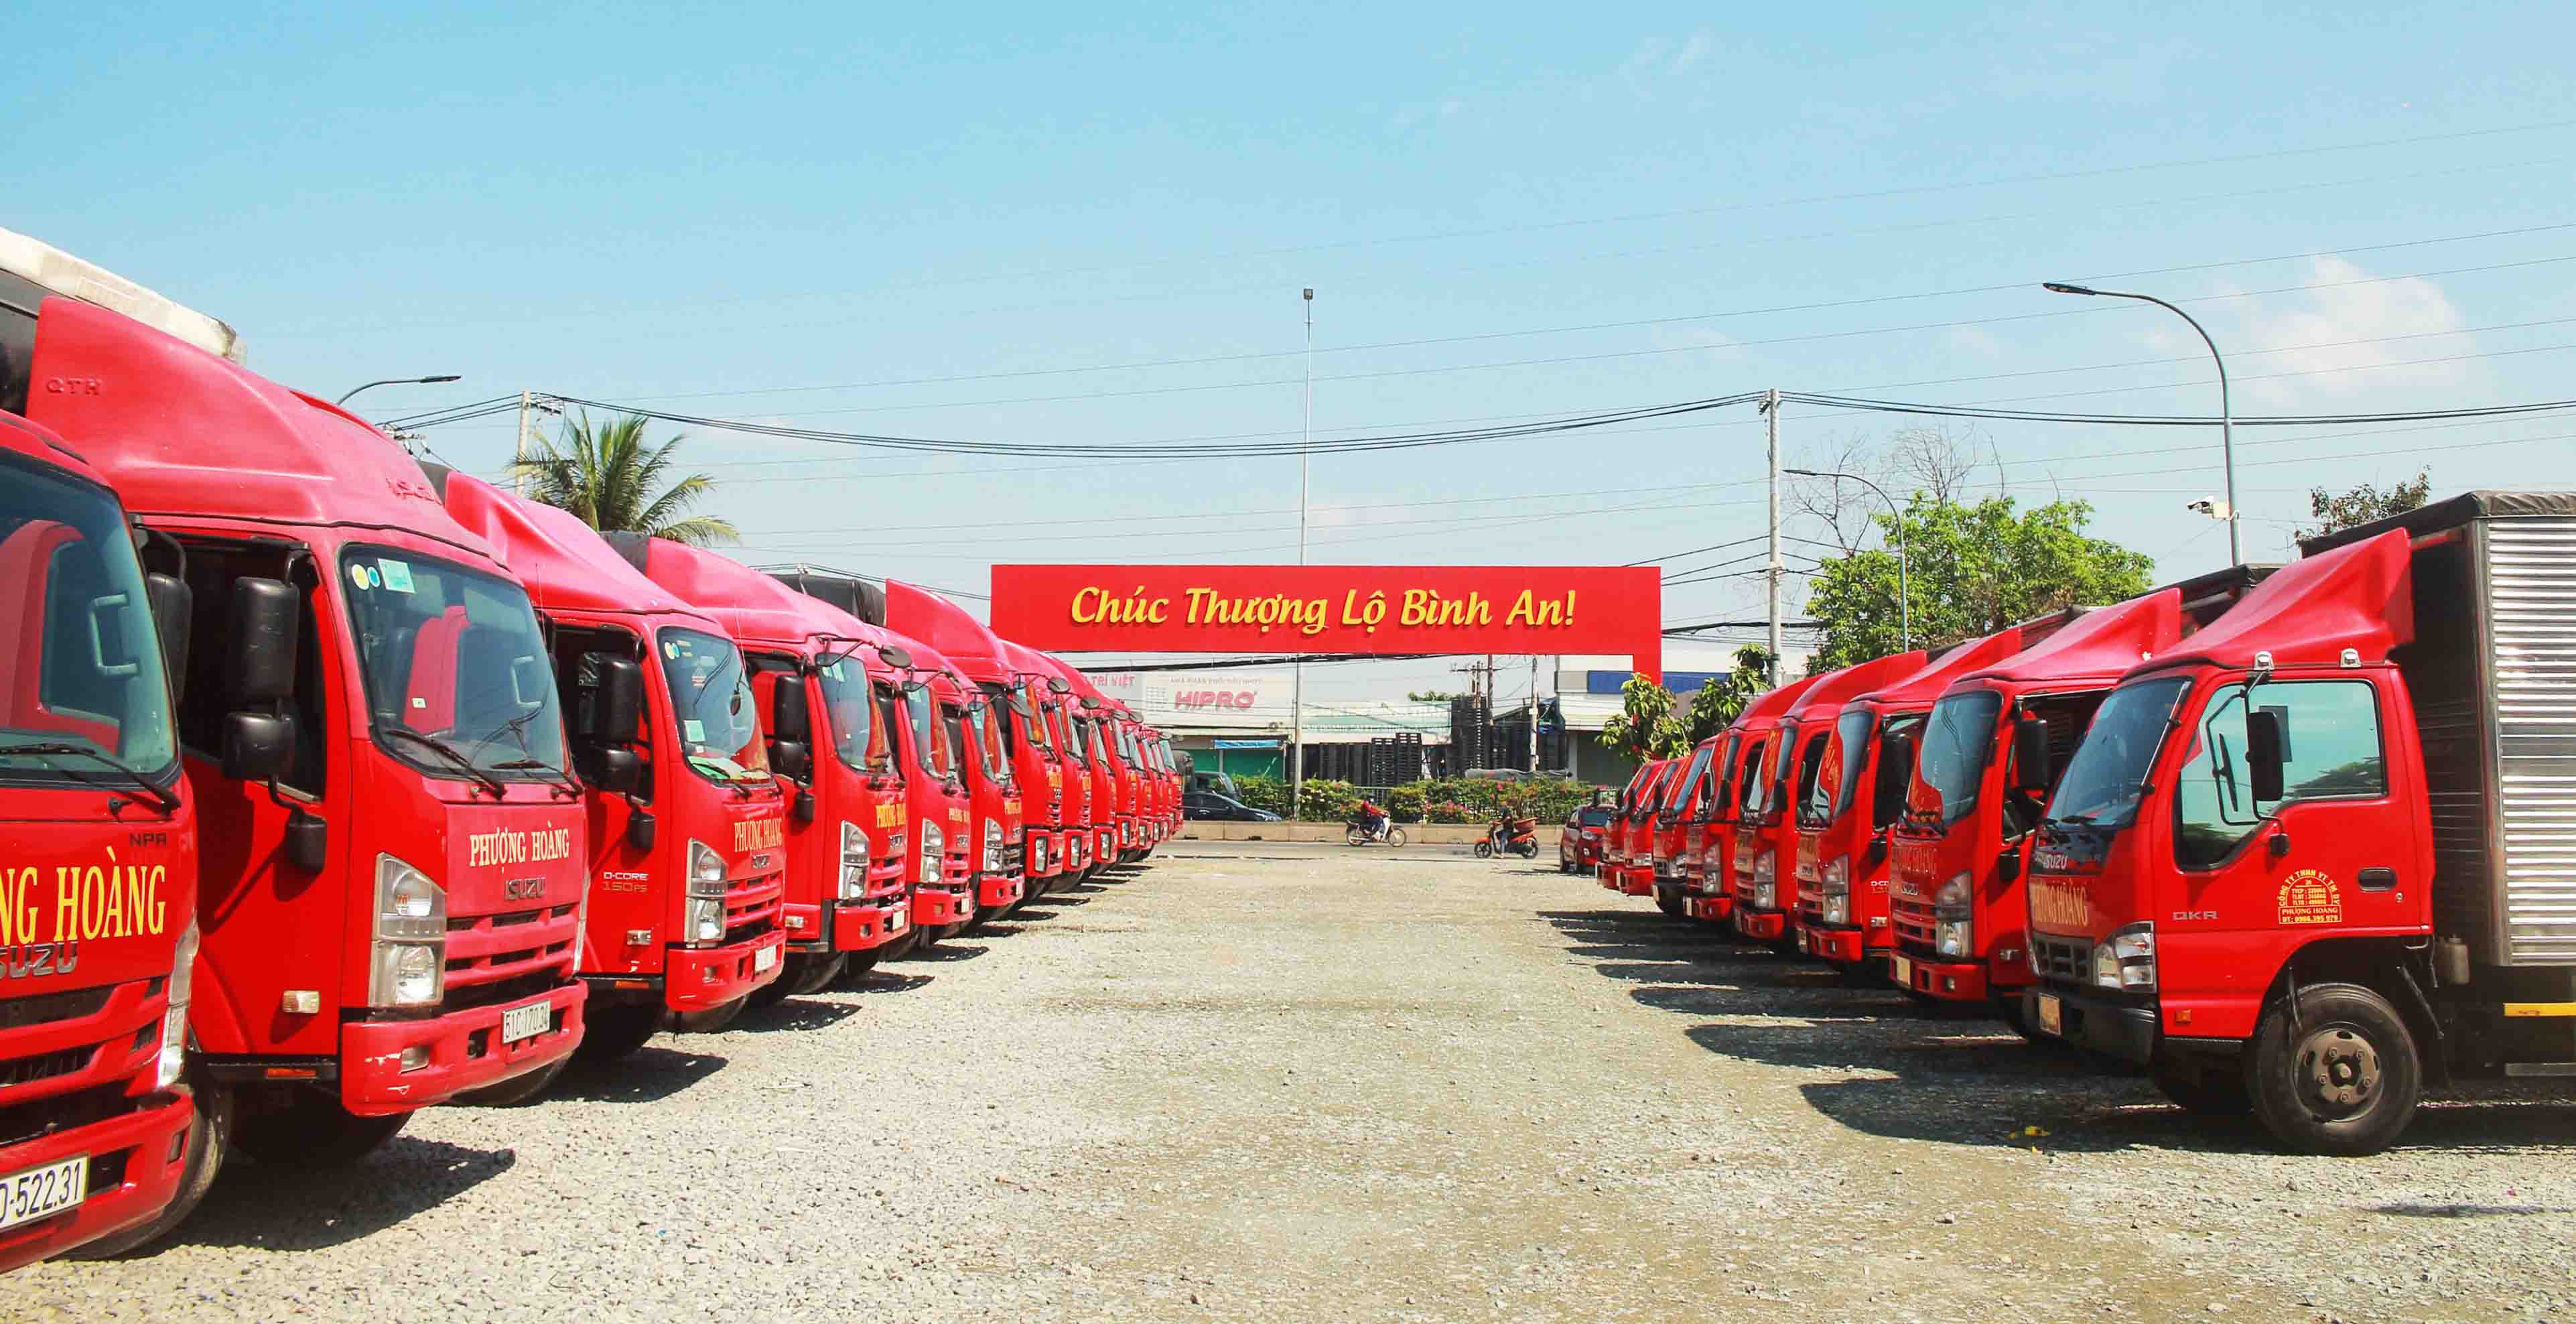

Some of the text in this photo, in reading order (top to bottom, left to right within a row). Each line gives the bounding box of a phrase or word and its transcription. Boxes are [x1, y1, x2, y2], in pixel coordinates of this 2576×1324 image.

[1071, 585, 1576, 635] Chúc Thượng Lộ Bình An!
[469, 819, 570, 874] PHƯỢNG HOÀNG
[53, 845, 166, 942] HOÀNG
